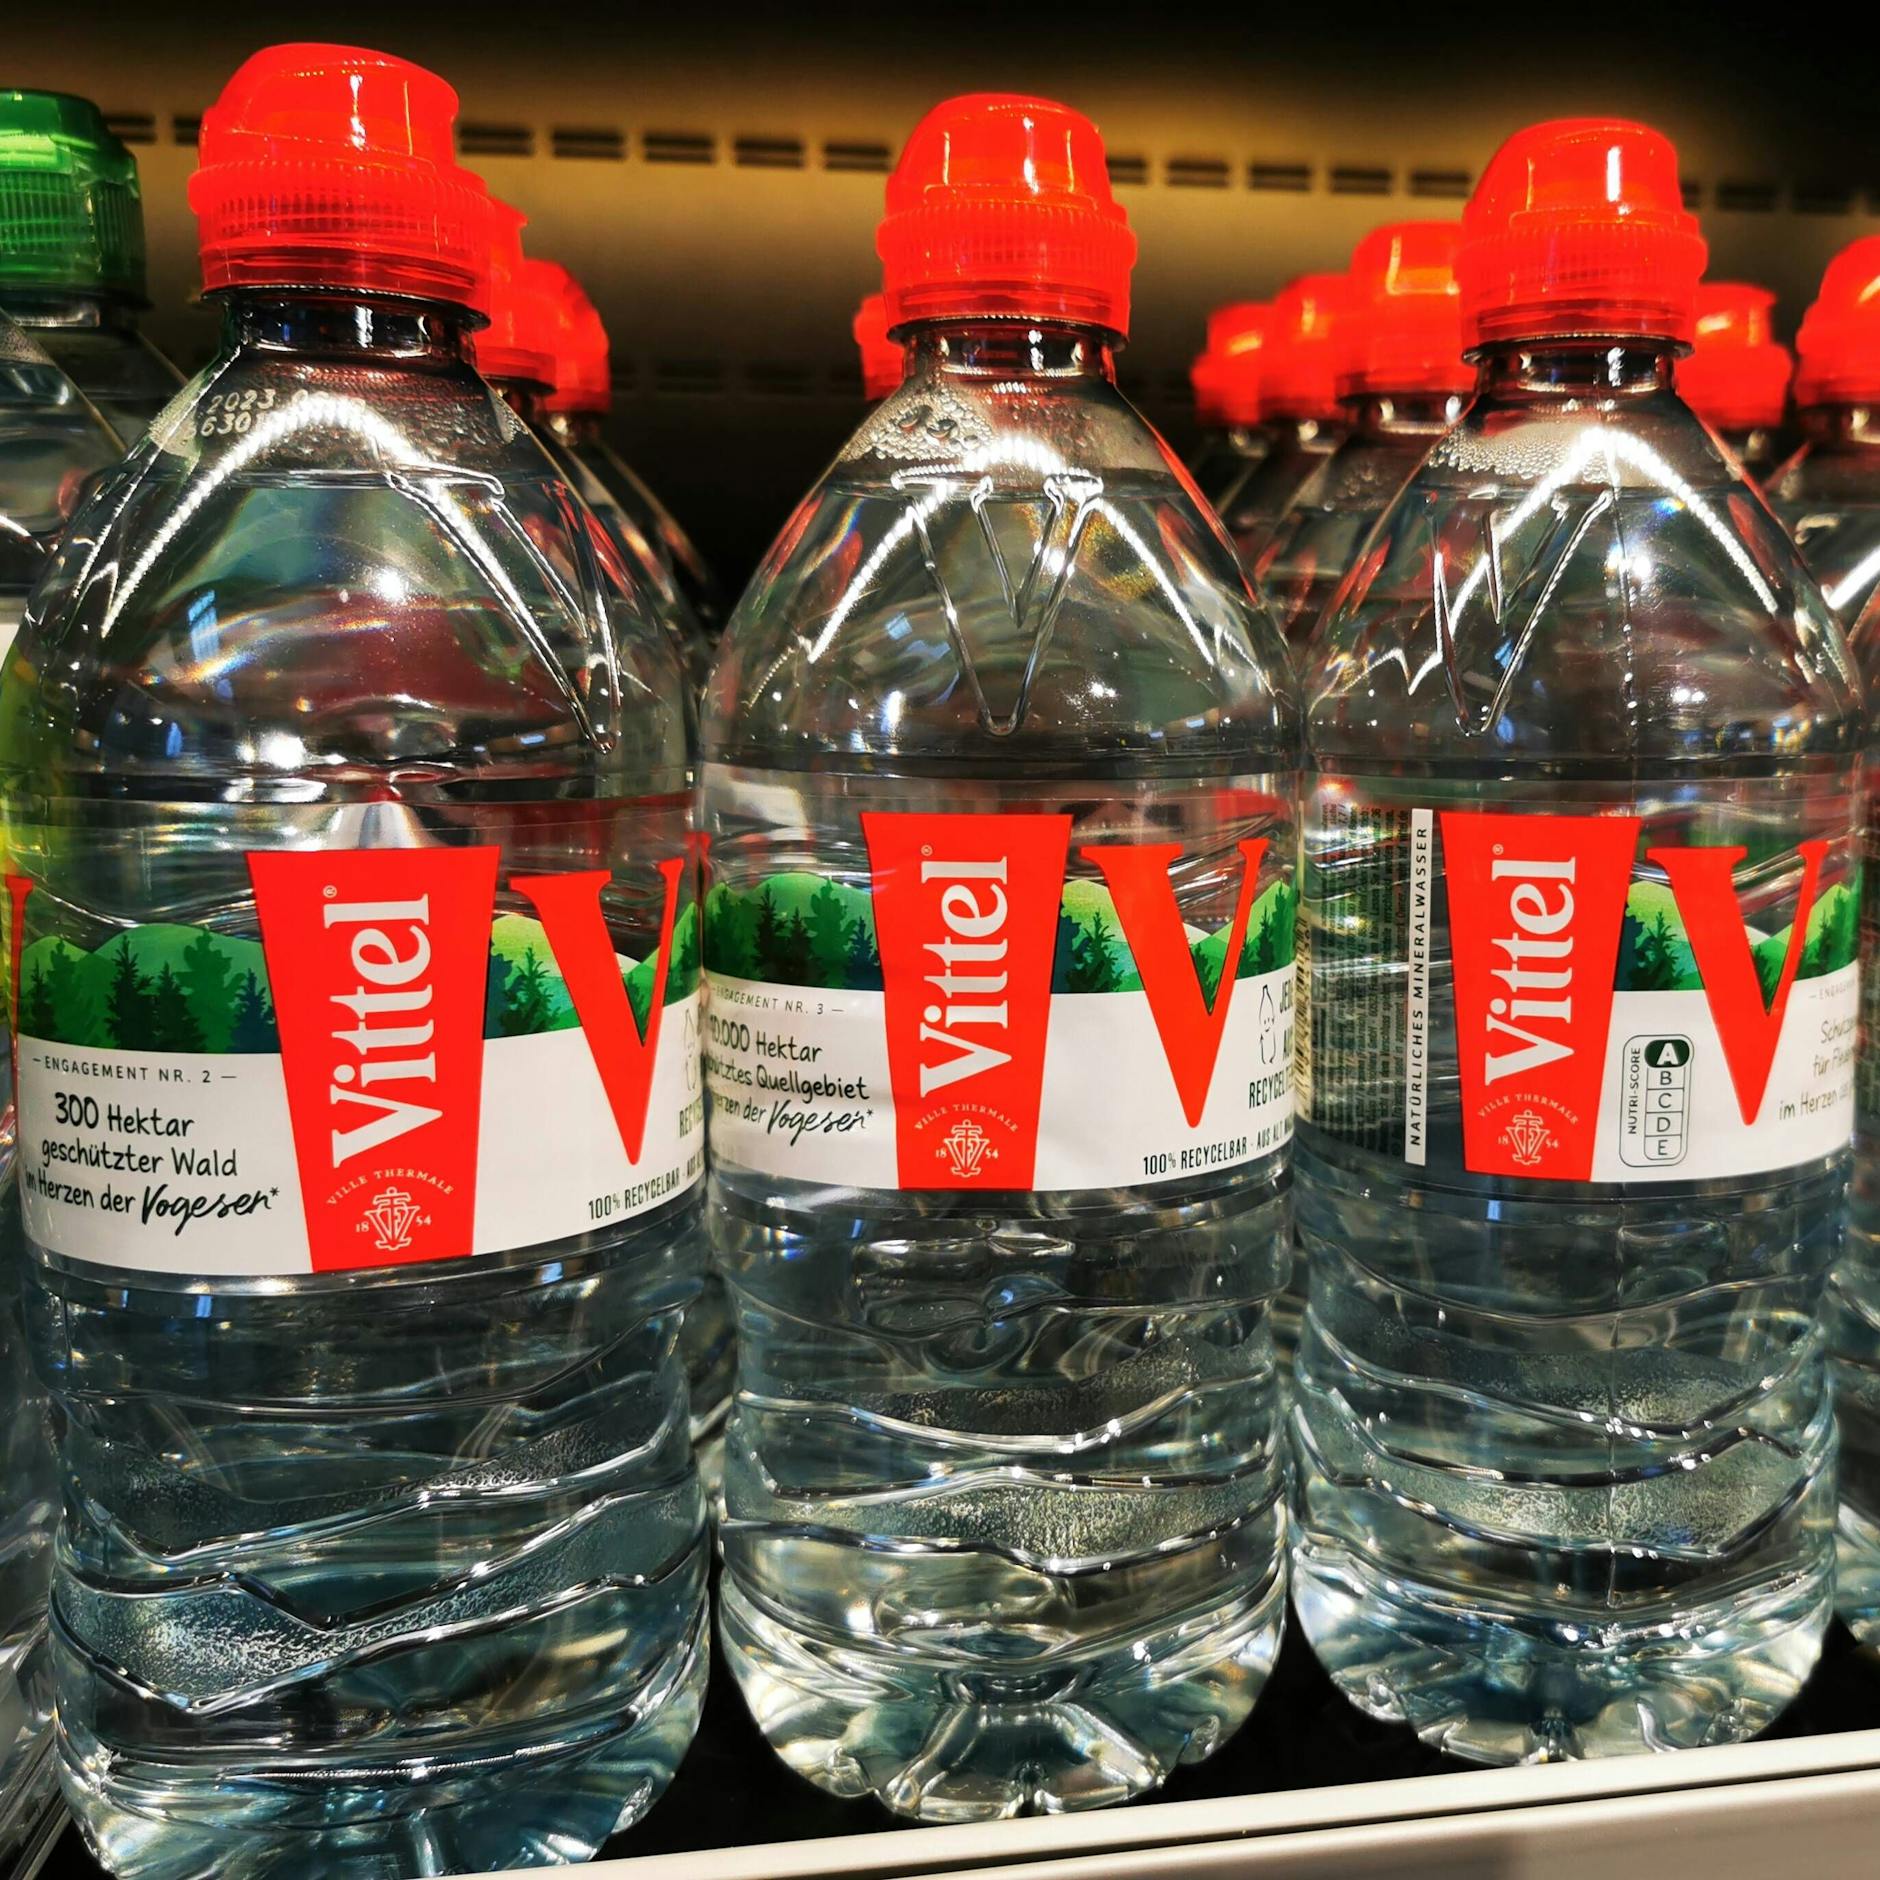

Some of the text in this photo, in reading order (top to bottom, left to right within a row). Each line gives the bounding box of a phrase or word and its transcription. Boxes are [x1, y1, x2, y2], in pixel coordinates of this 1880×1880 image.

[206, 388, 276, 414] 2023
[1410, 828, 1427, 1146] NATÜRLICHES MINERALWASSER
[785, 1000, 808, 1015] NR.
[816, 1003, 824, 1015] 3
[755, 1030, 824, 1063] Hektar
[1656, 1042, 1679, 1066] A
[45, 1055, 212, 1083] ENGAGEMENT NR. 2
[756, 1064, 870, 1104] Quellgebiet
[1660, 1071, 1672, 1086] B
[1628, 1047, 1641, 1135] NUTRI-SCORE
[1658, 1092, 1672, 1109] C
[1778, 1091, 1838, 1120] im Herzen
[54, 1092, 195, 1137] 300 Hektar
[743, 1097, 767, 1123] der
[914, 1103, 1018, 1133] VILLE THERMALE
[1477, 1093, 1580, 1125] VILLE THERMALE
[1656, 1116, 1671, 1133] D
[42, 1137, 238, 1177] geschützter Wald
[1143, 1151, 1176, 1175] 100%
[1181, 1136, 1247, 1170] RECYCELBAR
[1257, 1128, 1270, 1151] AUS
[1658, 1139, 1668, 1156] E
[38, 1167, 94, 1208] Herzen
[100, 1183, 136, 1213] der
[326, 1167, 455, 1206] VILLE THERMALE
[588, 1192, 621, 1220] 100%
[624, 1167, 680, 1210] RECYCELBAR
